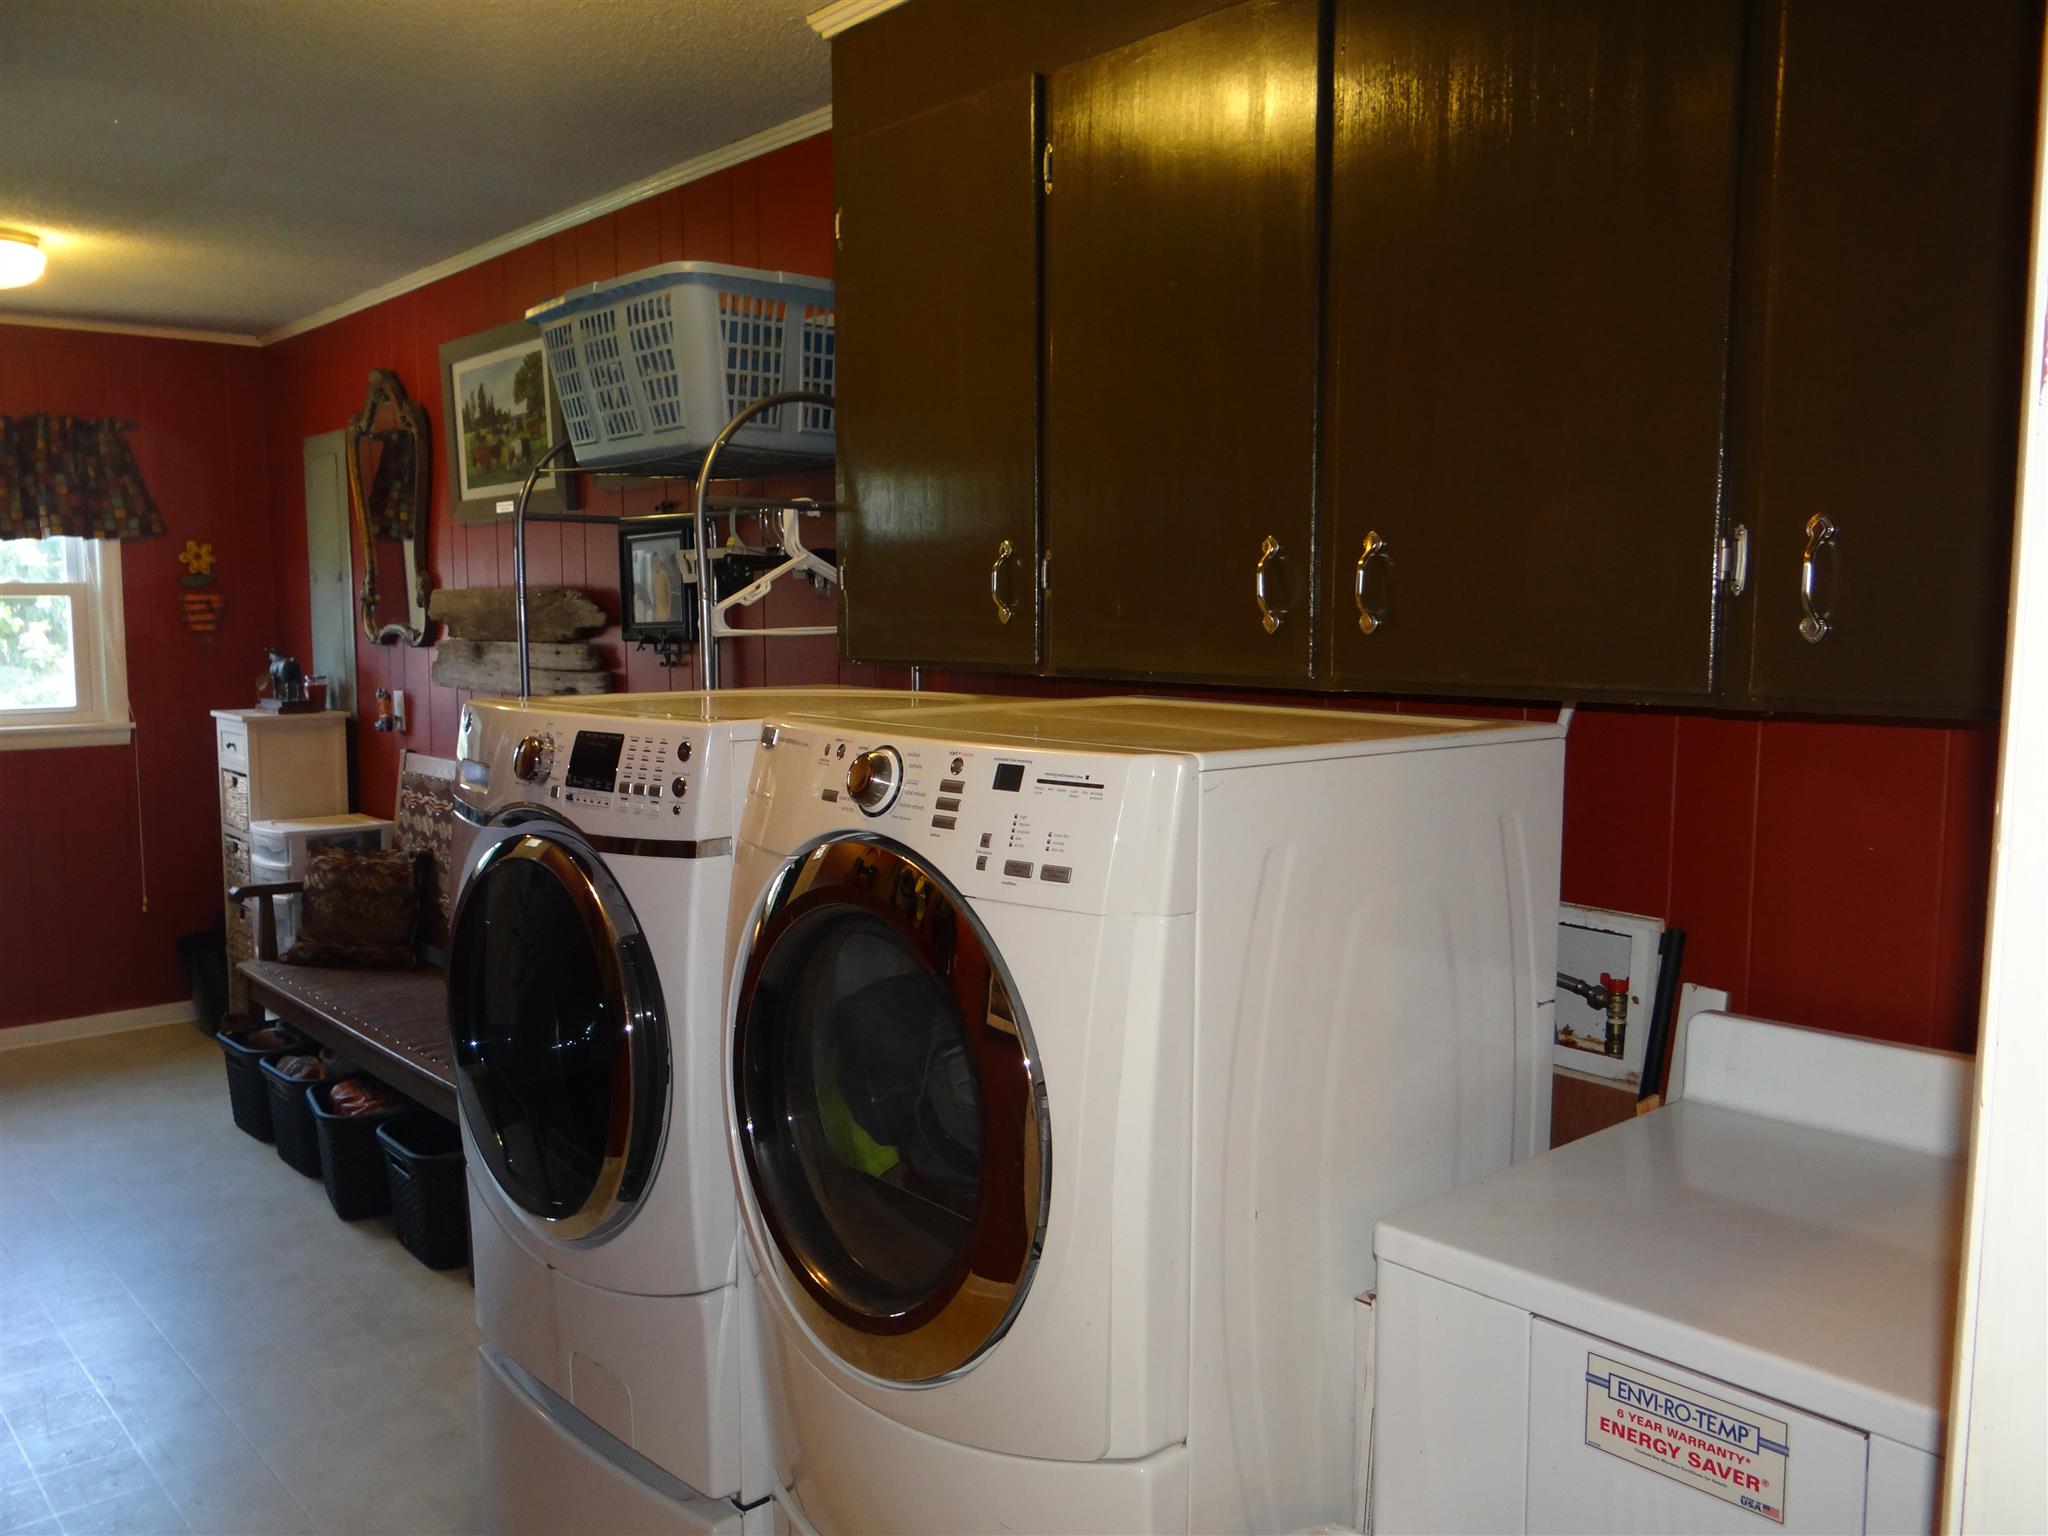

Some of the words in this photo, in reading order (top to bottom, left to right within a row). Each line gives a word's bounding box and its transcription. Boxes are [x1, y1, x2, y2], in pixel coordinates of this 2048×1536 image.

[1616, 1408, 1625, 1419] 6
[1628, 1412, 1662, 1433] YEAR
[1617, 1380, 1749, 1443] ENVI-RO-TEMP
[1600, 1416, 1681, 1459] ENERGY
[1740, 1498, 1762, 1512] USA
